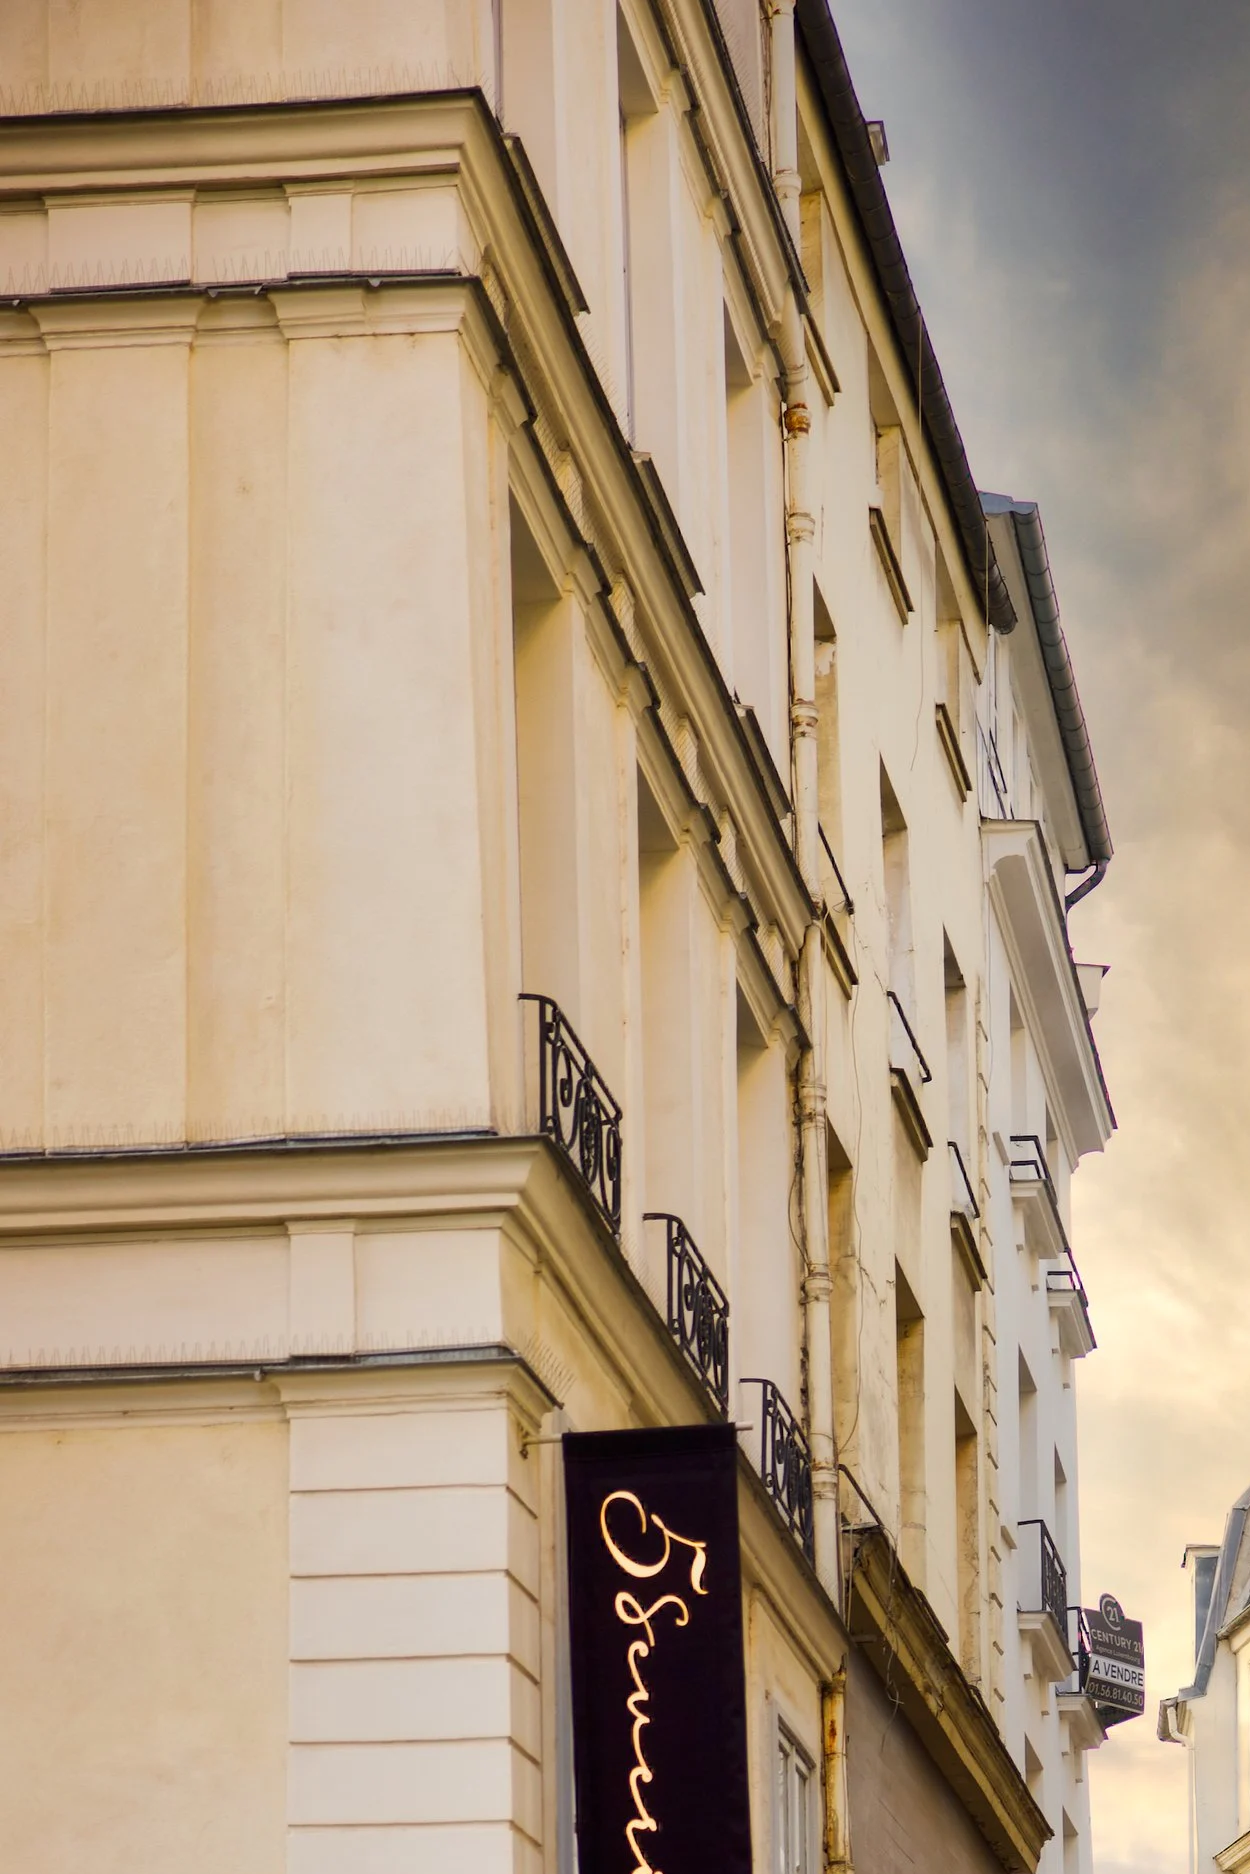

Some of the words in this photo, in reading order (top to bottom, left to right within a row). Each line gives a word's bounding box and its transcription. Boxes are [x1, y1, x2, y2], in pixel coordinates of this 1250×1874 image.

[600, 1490, 709, 1595] 5
[1091, 1629, 1132, 1650] CENTURY
[1093, 1660, 1101, 1673] A
[1103, 1662, 1144, 1686] VENDRE
